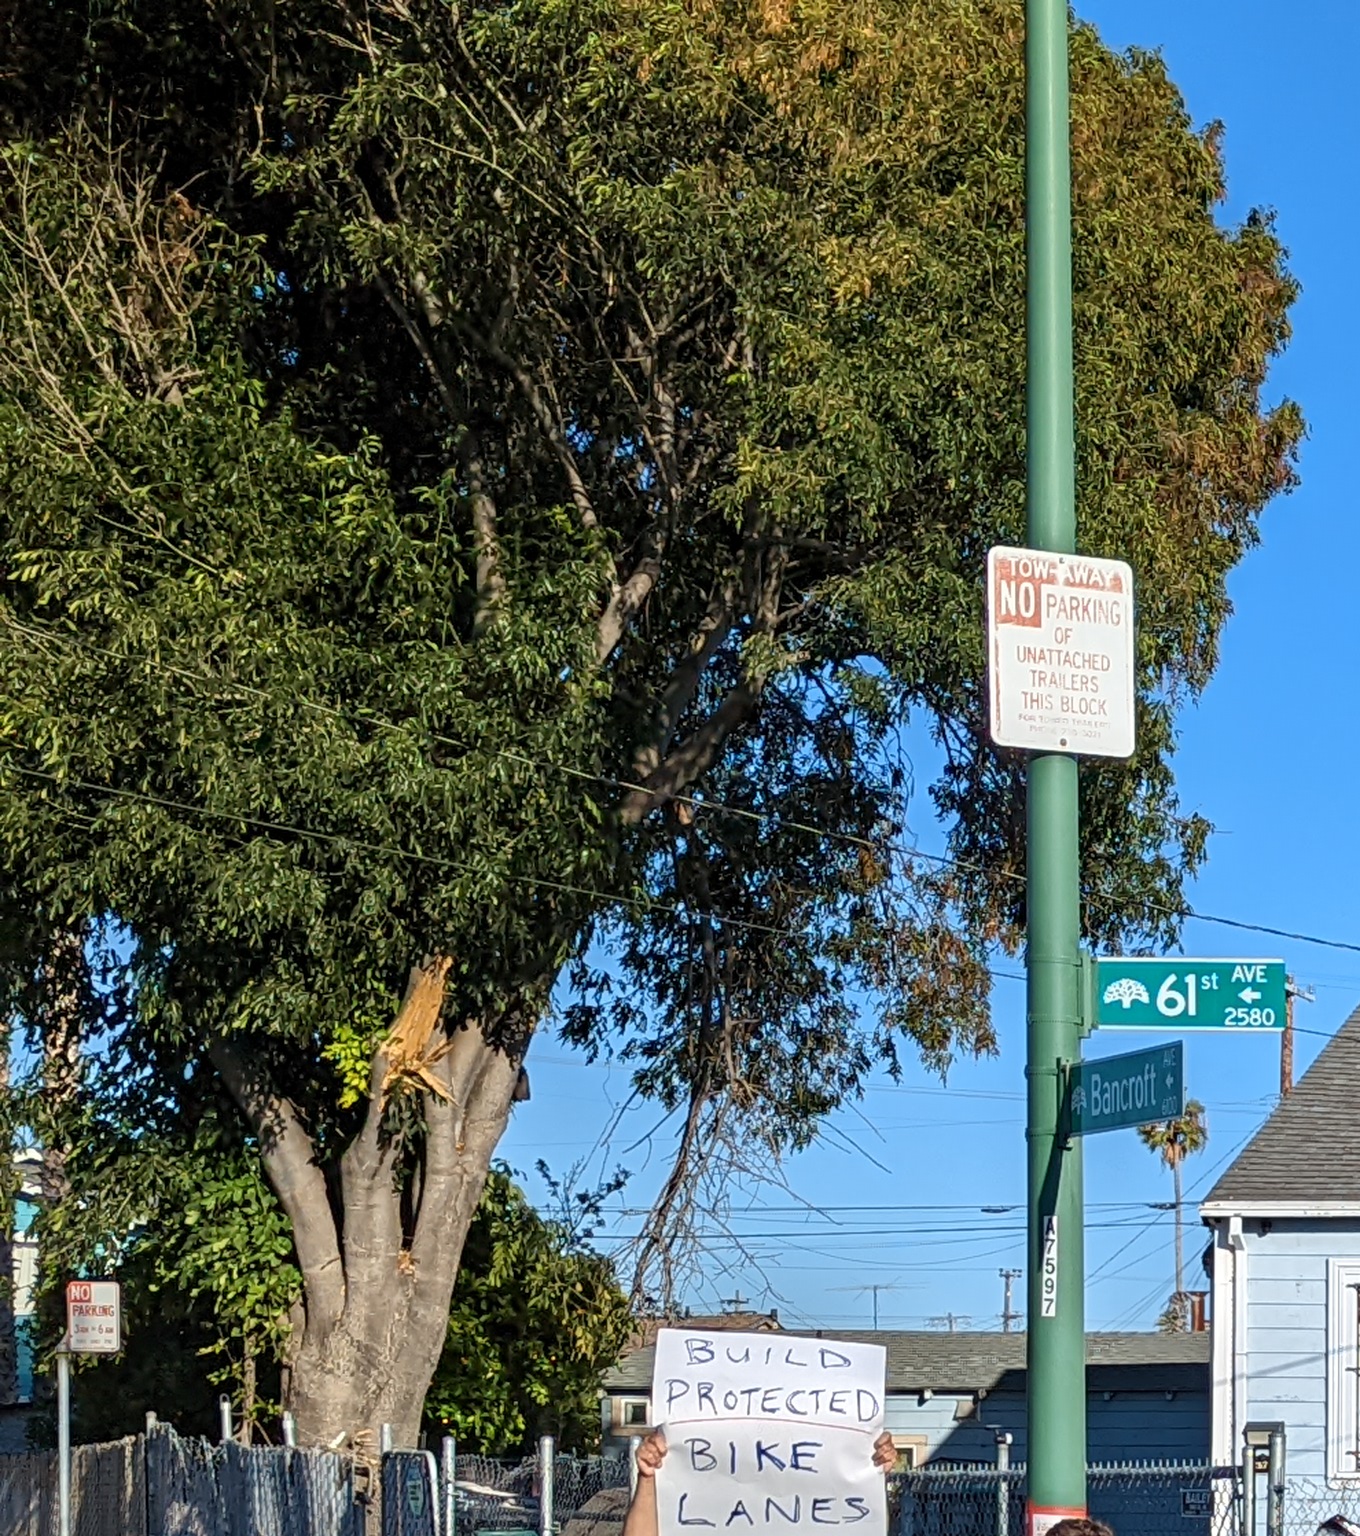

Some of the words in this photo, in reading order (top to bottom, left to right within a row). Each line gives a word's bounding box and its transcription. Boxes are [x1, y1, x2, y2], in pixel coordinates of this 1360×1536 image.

[1001, 580, 1035, 619] NO
[1045, 593, 1121, 627] PARKING
[1054, 627, 1073, 645] OF
[1016, 645, 1111, 672] UNATTACHED
[1030, 669, 1099, 694] TRAILERS
[1021, 691, 1053, 711] THIS
[1060, 695, 1107, 716] BLOCK
[1230, 965, 1267, 984] AVE
[1224, 1007, 1275, 1027] 2580
[1091, 1063, 1157, 1117] Bancroft
[1043, 1217, 1057, 1315] A7597
[71, 1285, 90, 1301] NO
[73, 1304, 115, 1317] PARKING
[685, 1337, 852, 1368] BUILD
[665, 1378, 880, 1423] PROTECTED
[684, 1437, 824, 1474] BIKE
[677, 1492, 871, 1528] LANES
